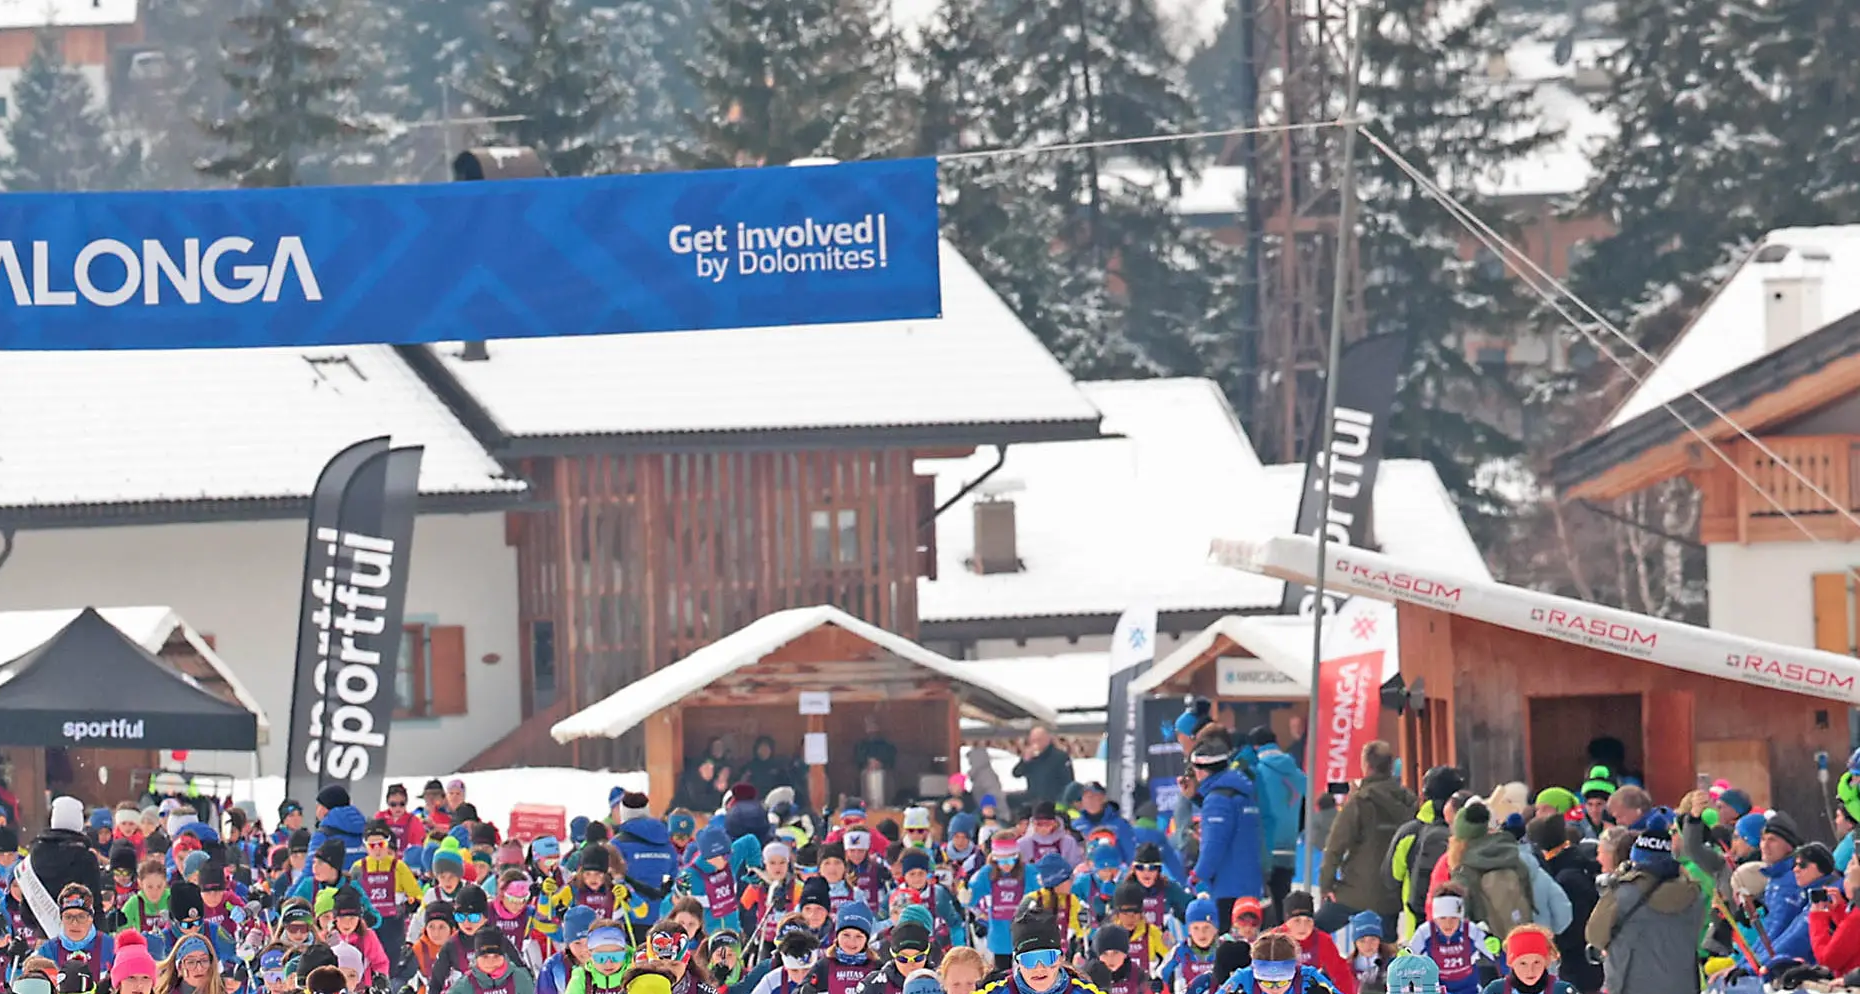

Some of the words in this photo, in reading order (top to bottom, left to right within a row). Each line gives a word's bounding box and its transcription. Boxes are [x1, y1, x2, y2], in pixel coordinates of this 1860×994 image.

[669, 224, 727, 254] Get
[696, 254, 728, 283] by
[739, 247, 875, 276] Dolomites
[1352, 564, 1461, 601] RASOM
[1548, 608, 1657, 648] RASOM
[327, 532, 394, 781] sportful
[1744, 655, 1855, 691] RASOM
[63, 719, 144, 741] sportful
